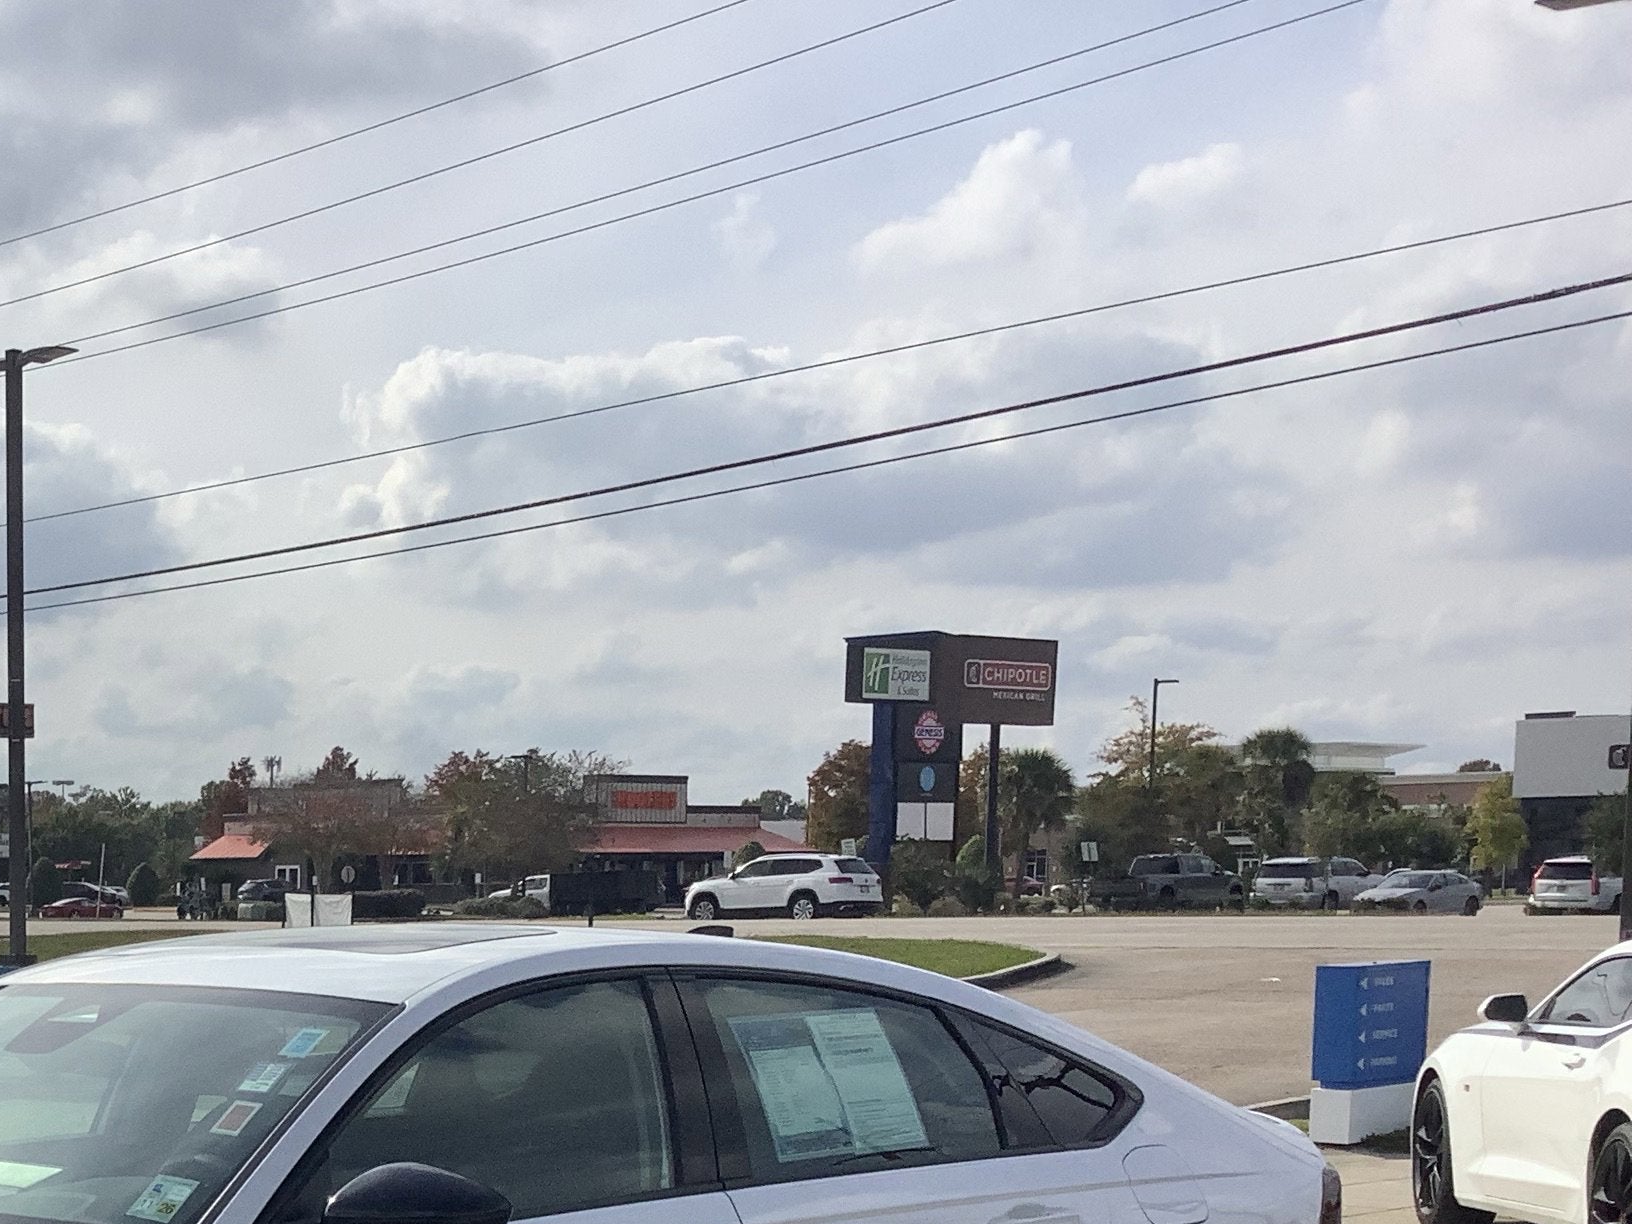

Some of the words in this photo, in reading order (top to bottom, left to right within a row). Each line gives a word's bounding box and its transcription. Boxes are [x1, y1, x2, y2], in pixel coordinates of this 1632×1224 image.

[891, 666, 928, 685] Express
[984, 666, 1047, 684] CHIPOTLE
[992, 691, 1024, 700] MEXICAN
[1025, 692, 1046, 702] GRILL
[157, 1202, 177, 1215] 26
